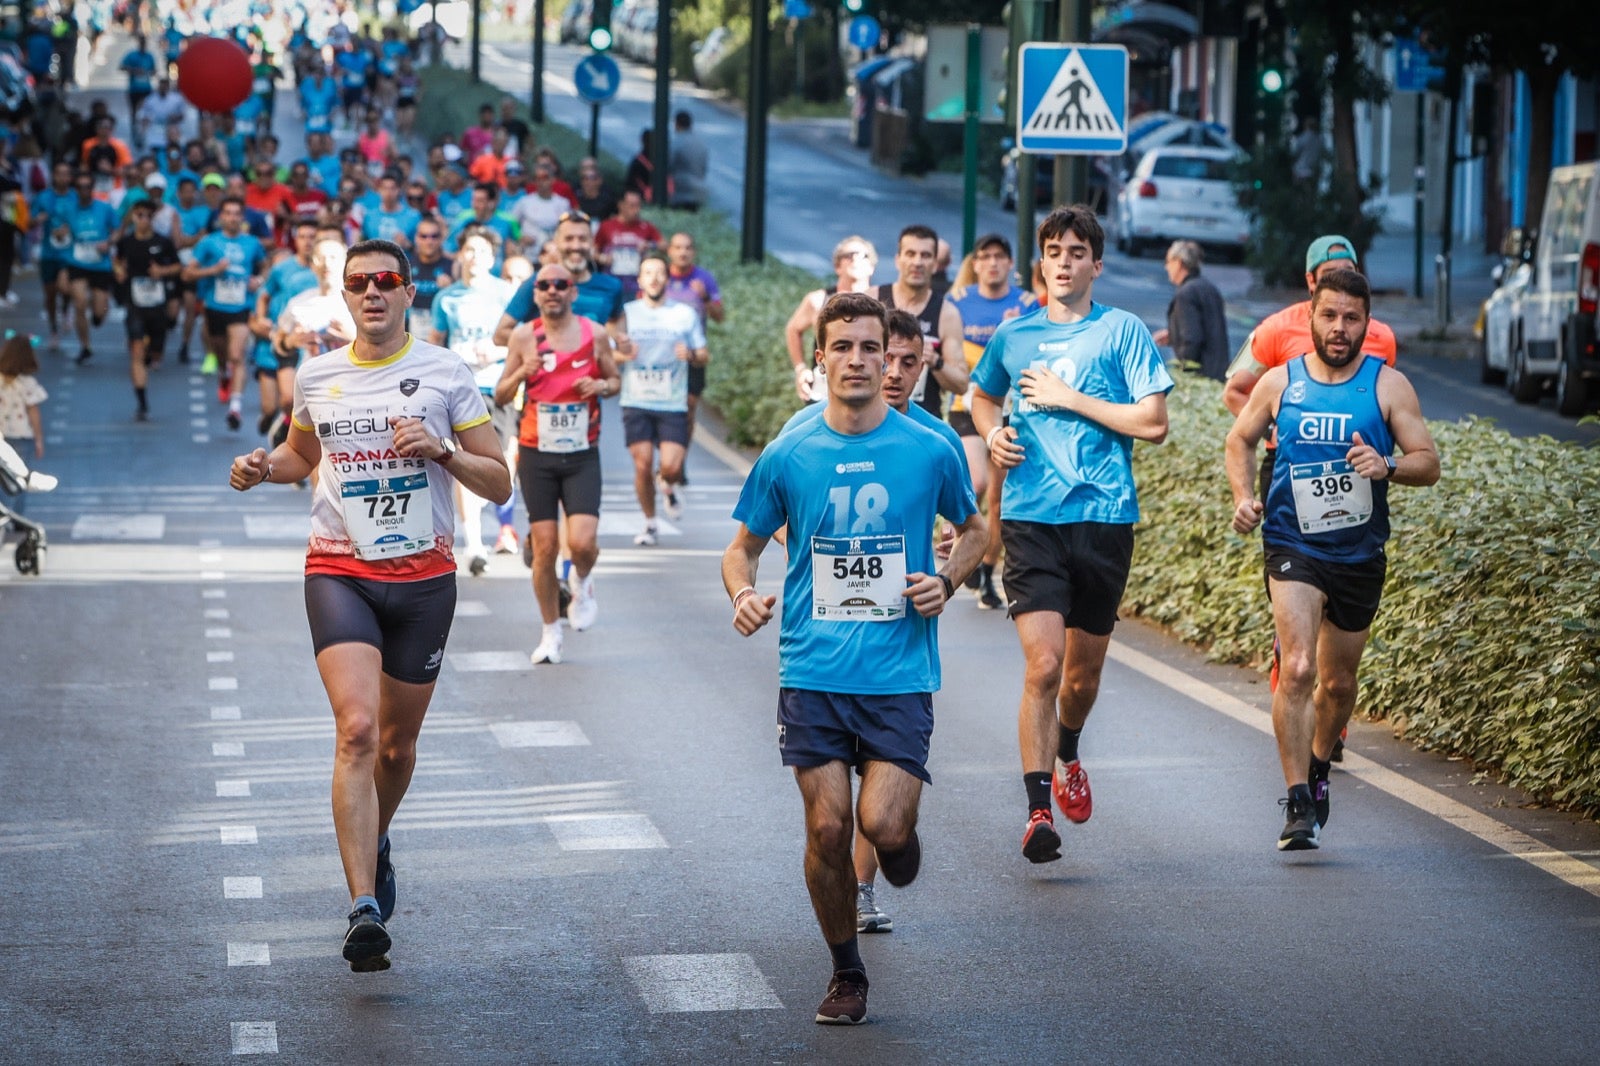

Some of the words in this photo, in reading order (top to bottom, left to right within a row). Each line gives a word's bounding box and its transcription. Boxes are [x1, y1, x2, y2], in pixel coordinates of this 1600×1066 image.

[551, 414, 577, 427] 887
[334, 459, 426, 474] UNNERS
[1311, 475, 1353, 497] 396
[363, 493, 411, 518] 727
[829, 483, 889, 536] 18
[375, 517, 405, 526] ENRIQUE
[833, 556, 884, 580] 548
